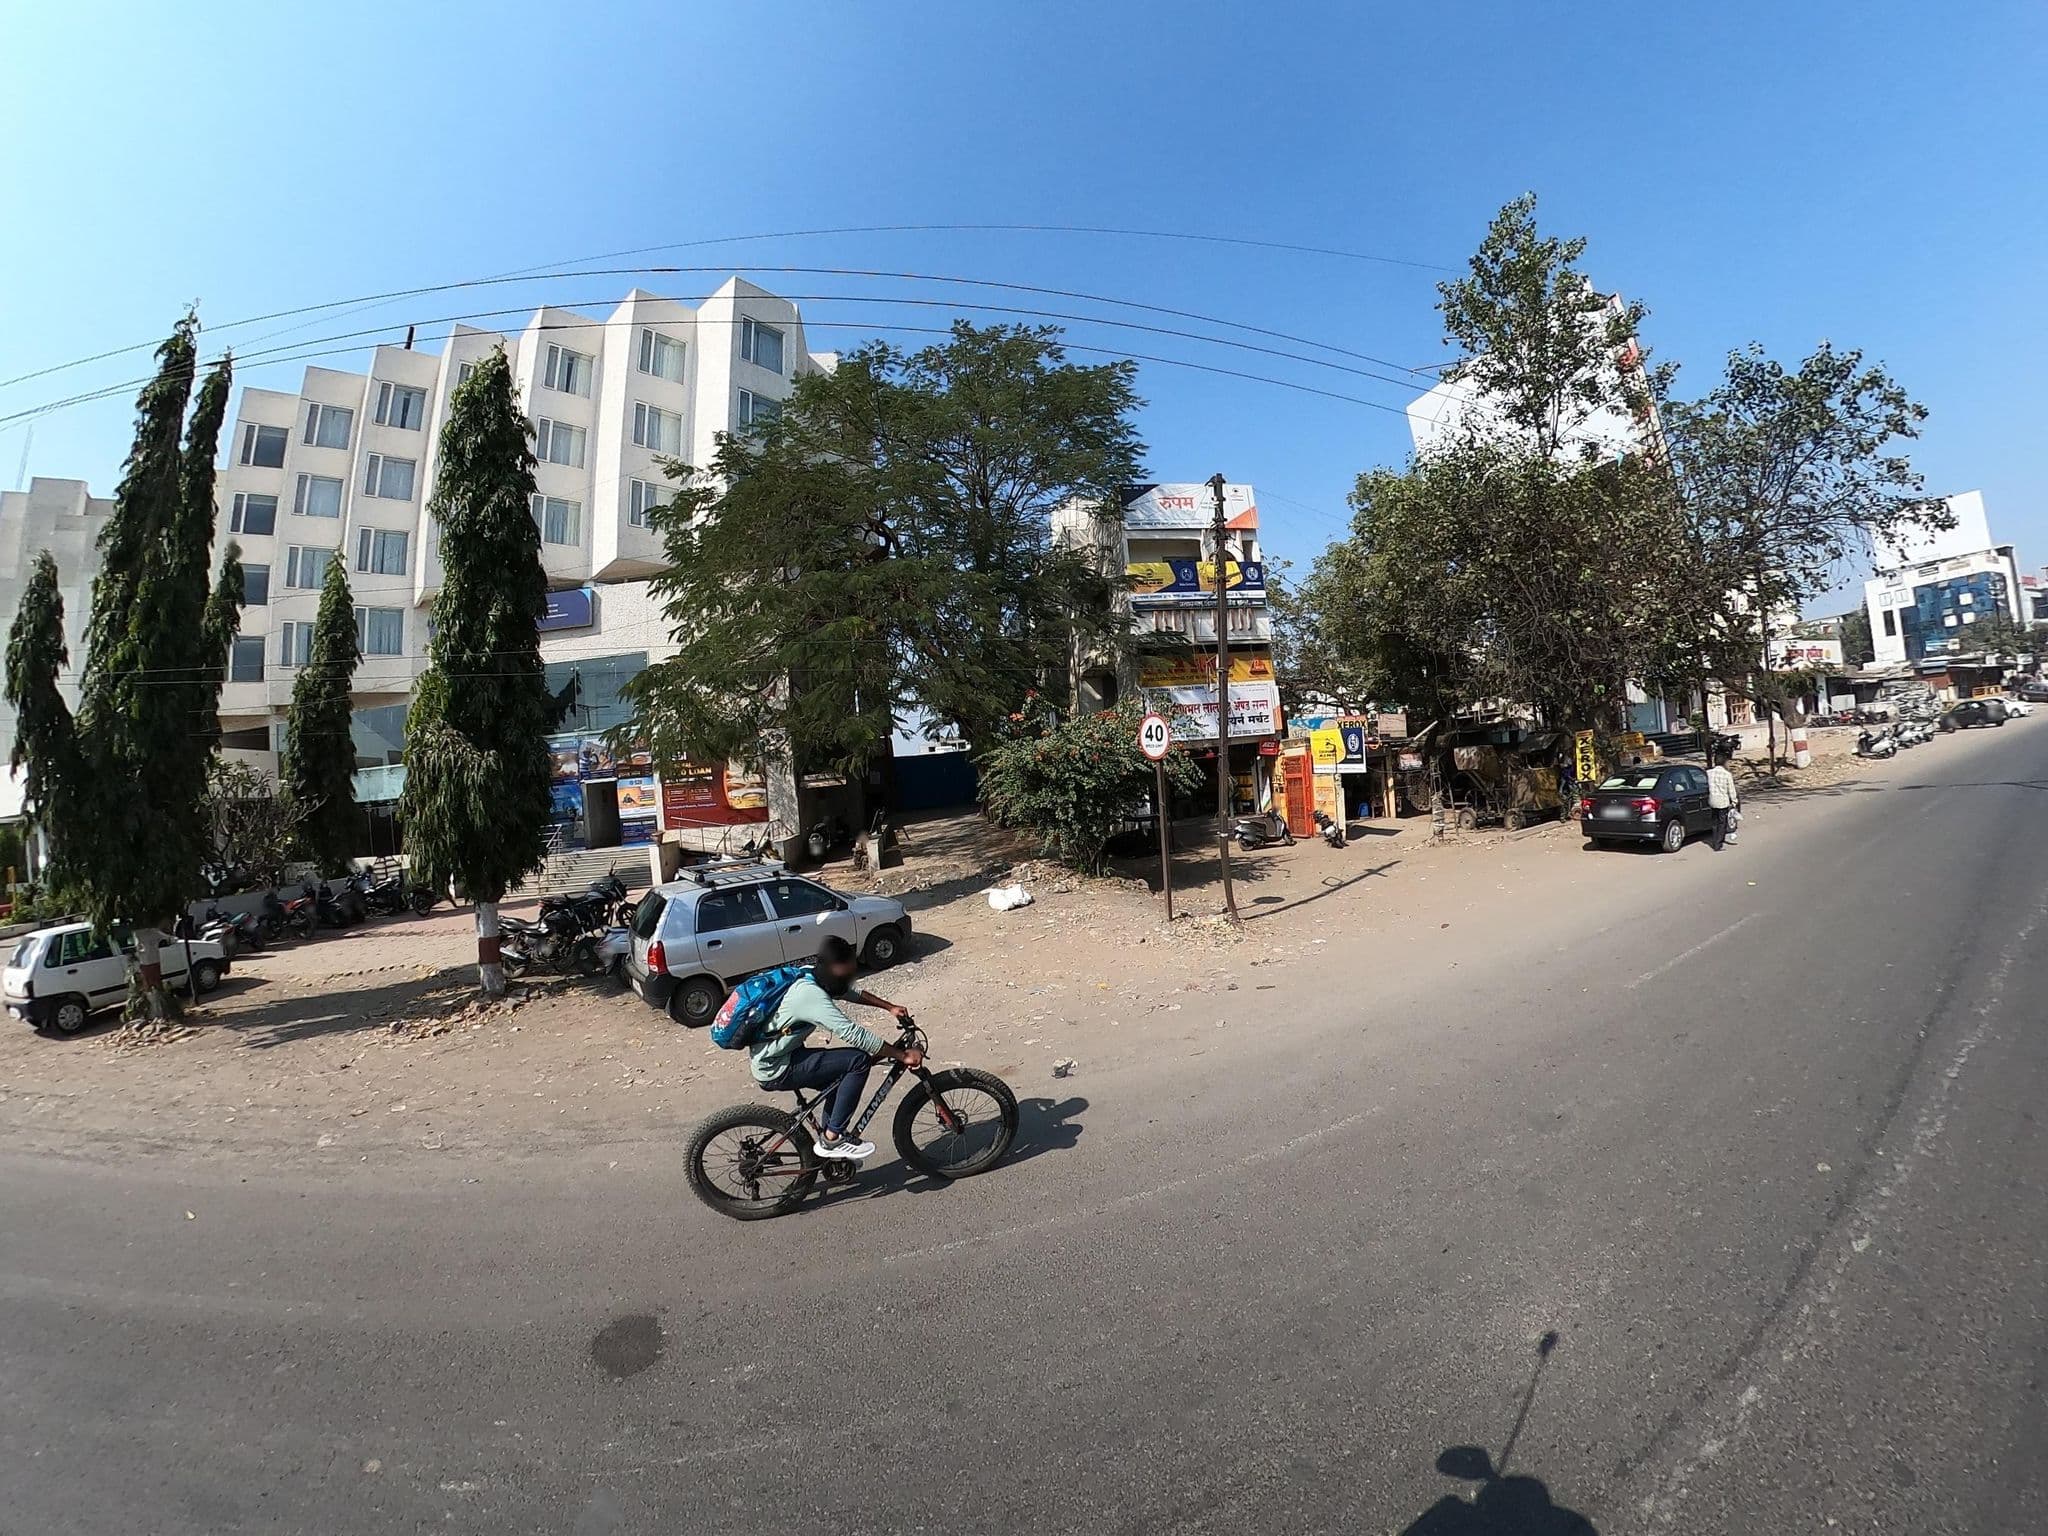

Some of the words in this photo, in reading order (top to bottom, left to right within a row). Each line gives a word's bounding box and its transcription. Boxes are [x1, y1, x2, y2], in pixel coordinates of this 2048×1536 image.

[1145, 724, 1164, 742] 40
[1337, 720, 1367, 729] XEROX
[1580, 737, 1592, 780] XEROX
